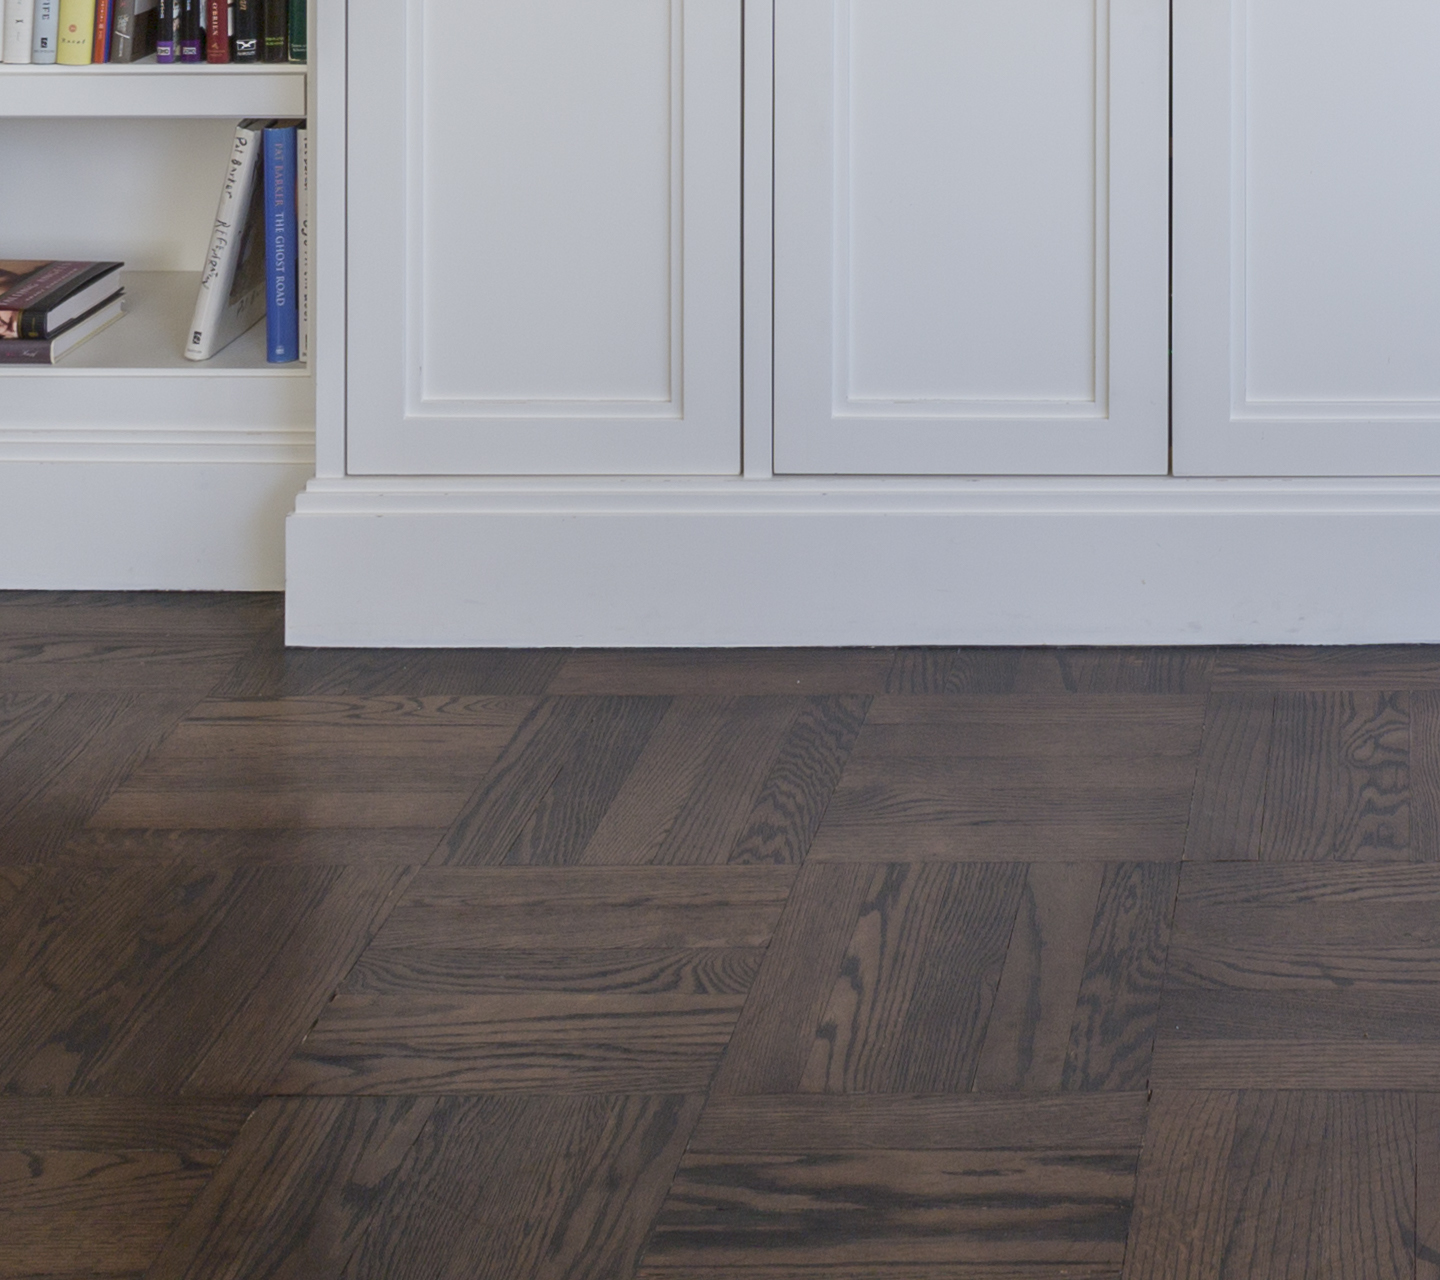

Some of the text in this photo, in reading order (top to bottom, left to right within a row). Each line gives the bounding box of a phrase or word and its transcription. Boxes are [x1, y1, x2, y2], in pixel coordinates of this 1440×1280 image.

[275, 212, 285, 306] THE GHOST ROAD
